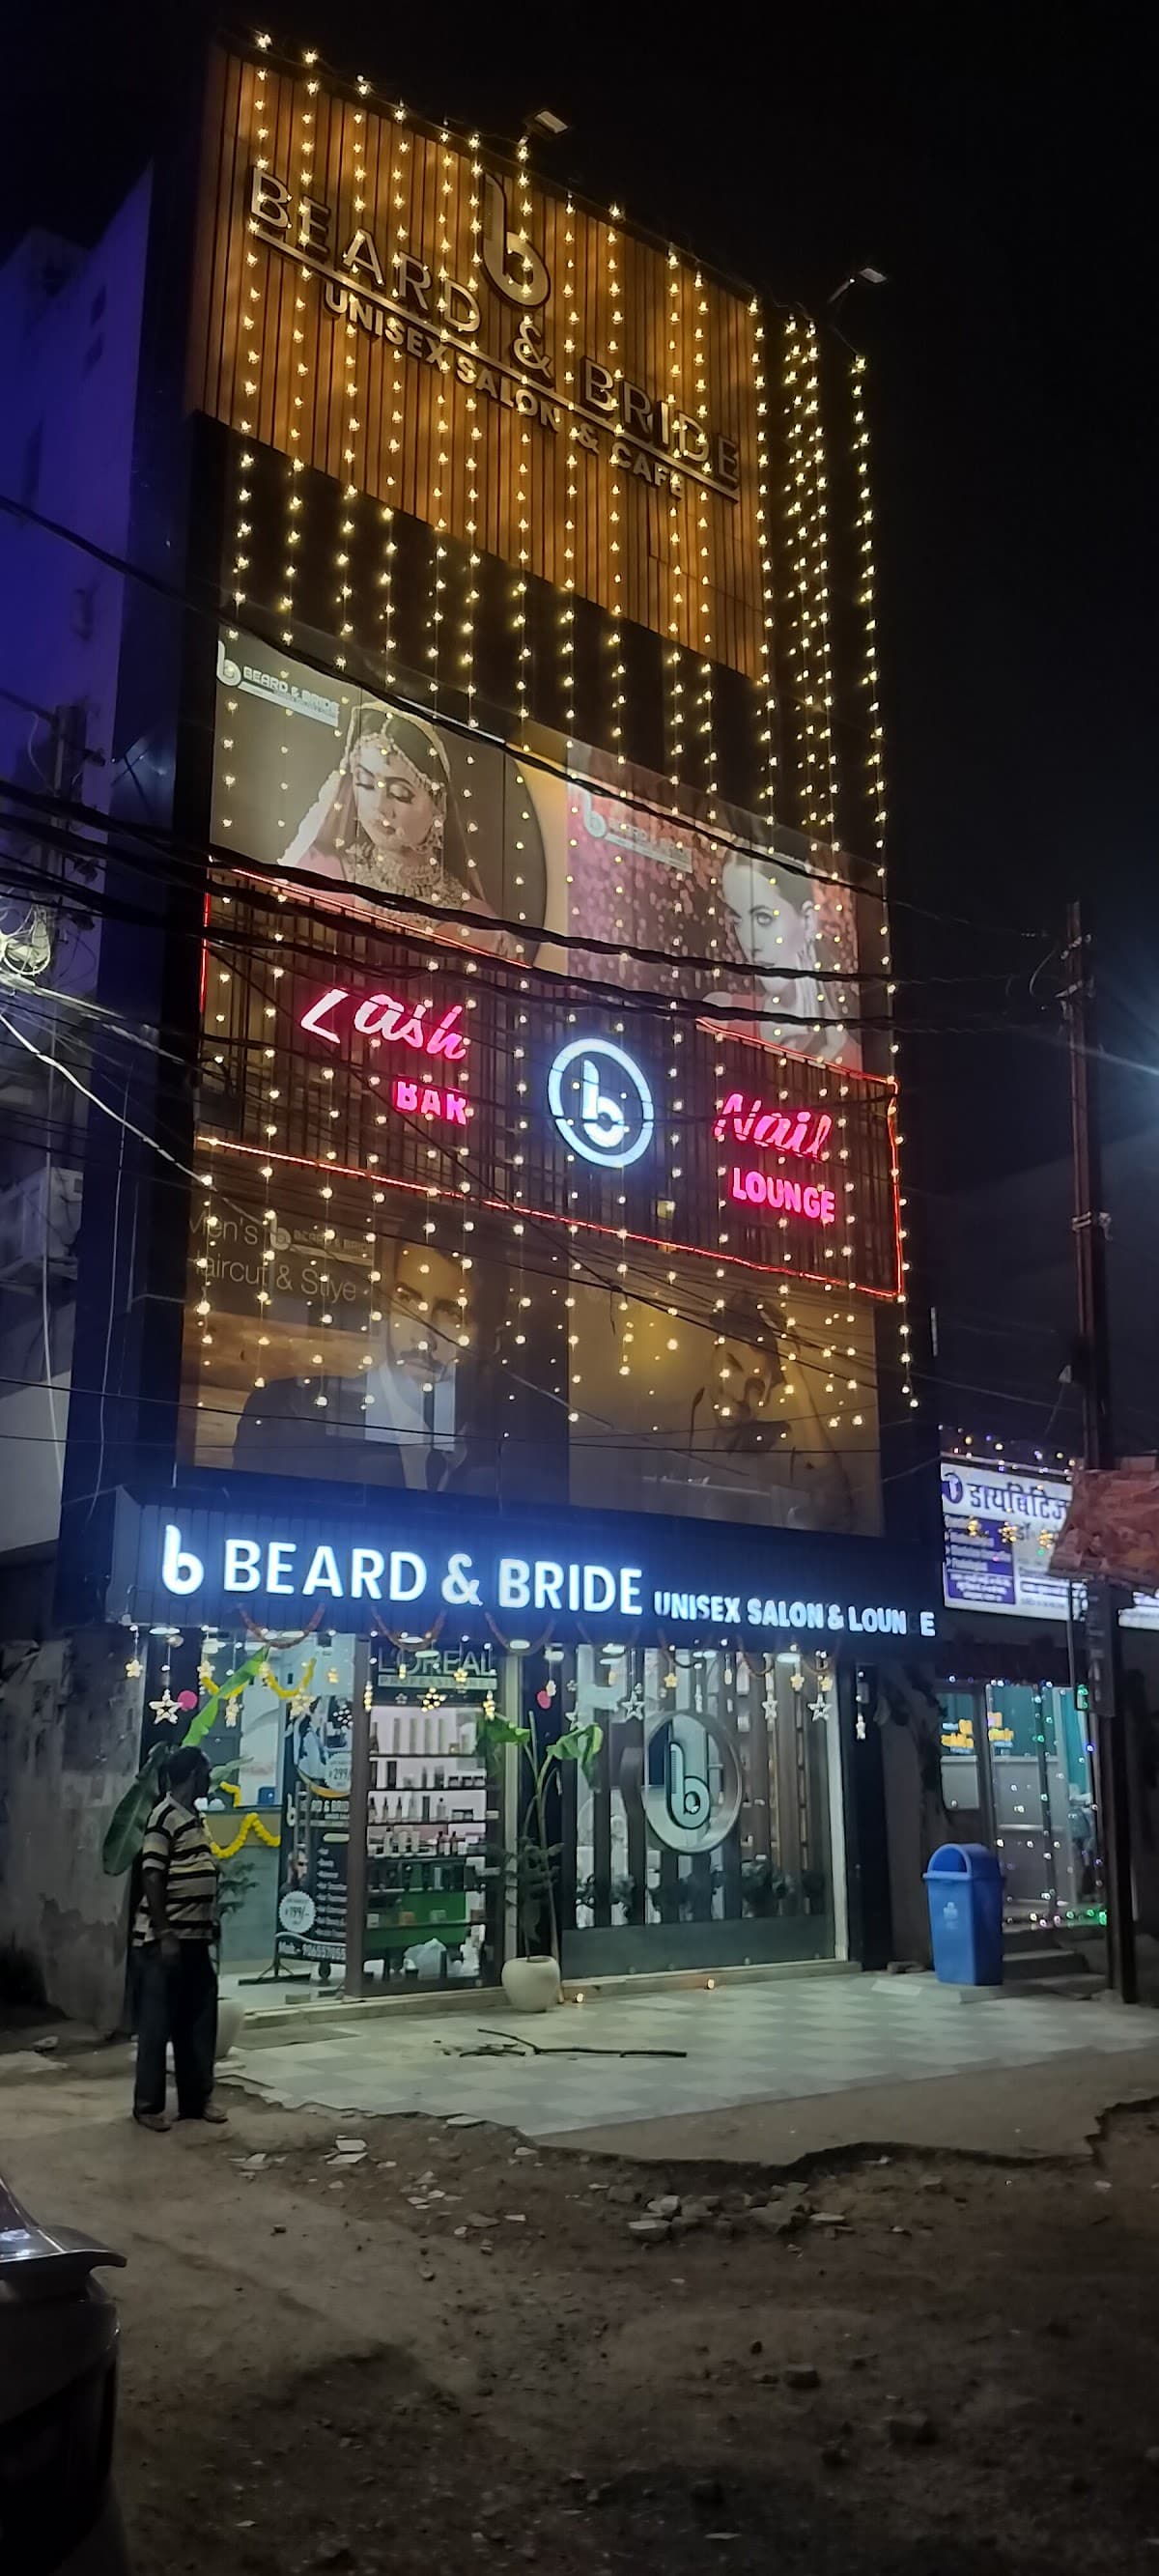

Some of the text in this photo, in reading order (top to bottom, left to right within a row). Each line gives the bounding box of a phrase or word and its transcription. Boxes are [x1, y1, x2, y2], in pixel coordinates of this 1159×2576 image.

[251, 167, 740, 484] BEARD & BRIDE
[325, 281, 446, 370] UNISEX
[457, 354, 560, 433] SALON
[580, 424, 601, 455] &
[243, 665, 289, 693] BEARD
[300, 988, 466, 1060] Lash
[397, 1077, 467, 1125] BAR
[714, 1093, 832, 1159] Nail
[732, 1167, 835, 1224] LOUNGE
[276, 1264, 293, 1290] &
[223, 1539, 936, 1637] BEARD & BRIDE UNISEX SALON & LOUNE
